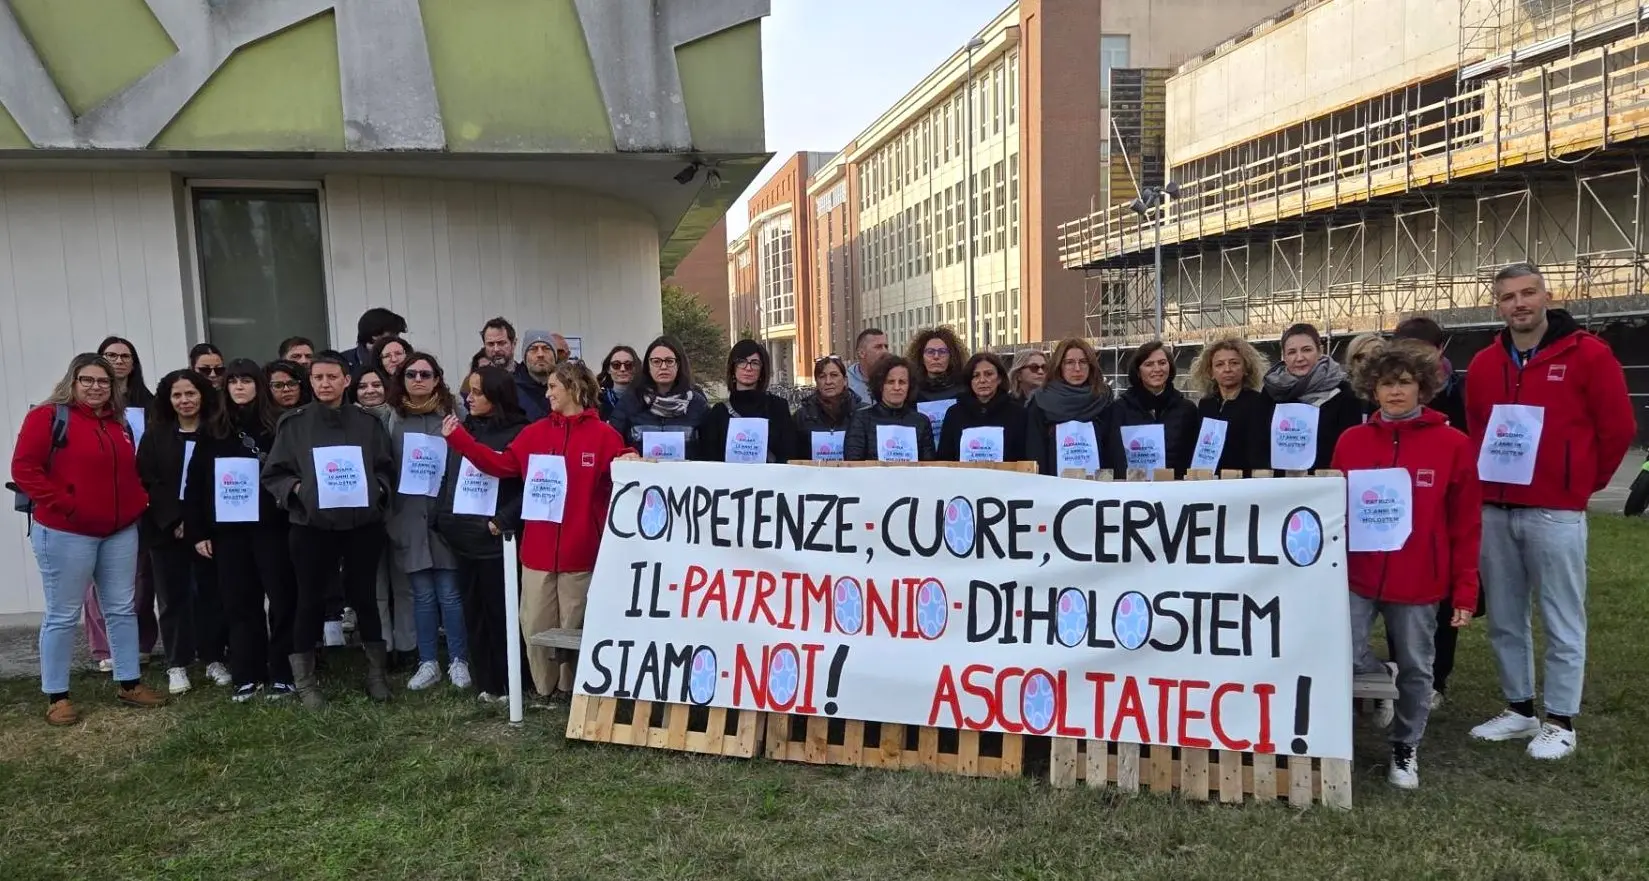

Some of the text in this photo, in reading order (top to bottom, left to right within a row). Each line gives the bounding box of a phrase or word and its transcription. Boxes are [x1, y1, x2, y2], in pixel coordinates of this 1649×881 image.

[625, 561, 1281, 658] IL PATRIMONIO DI HOLOSTEM
[582, 639, 718, 706] SIAMO
